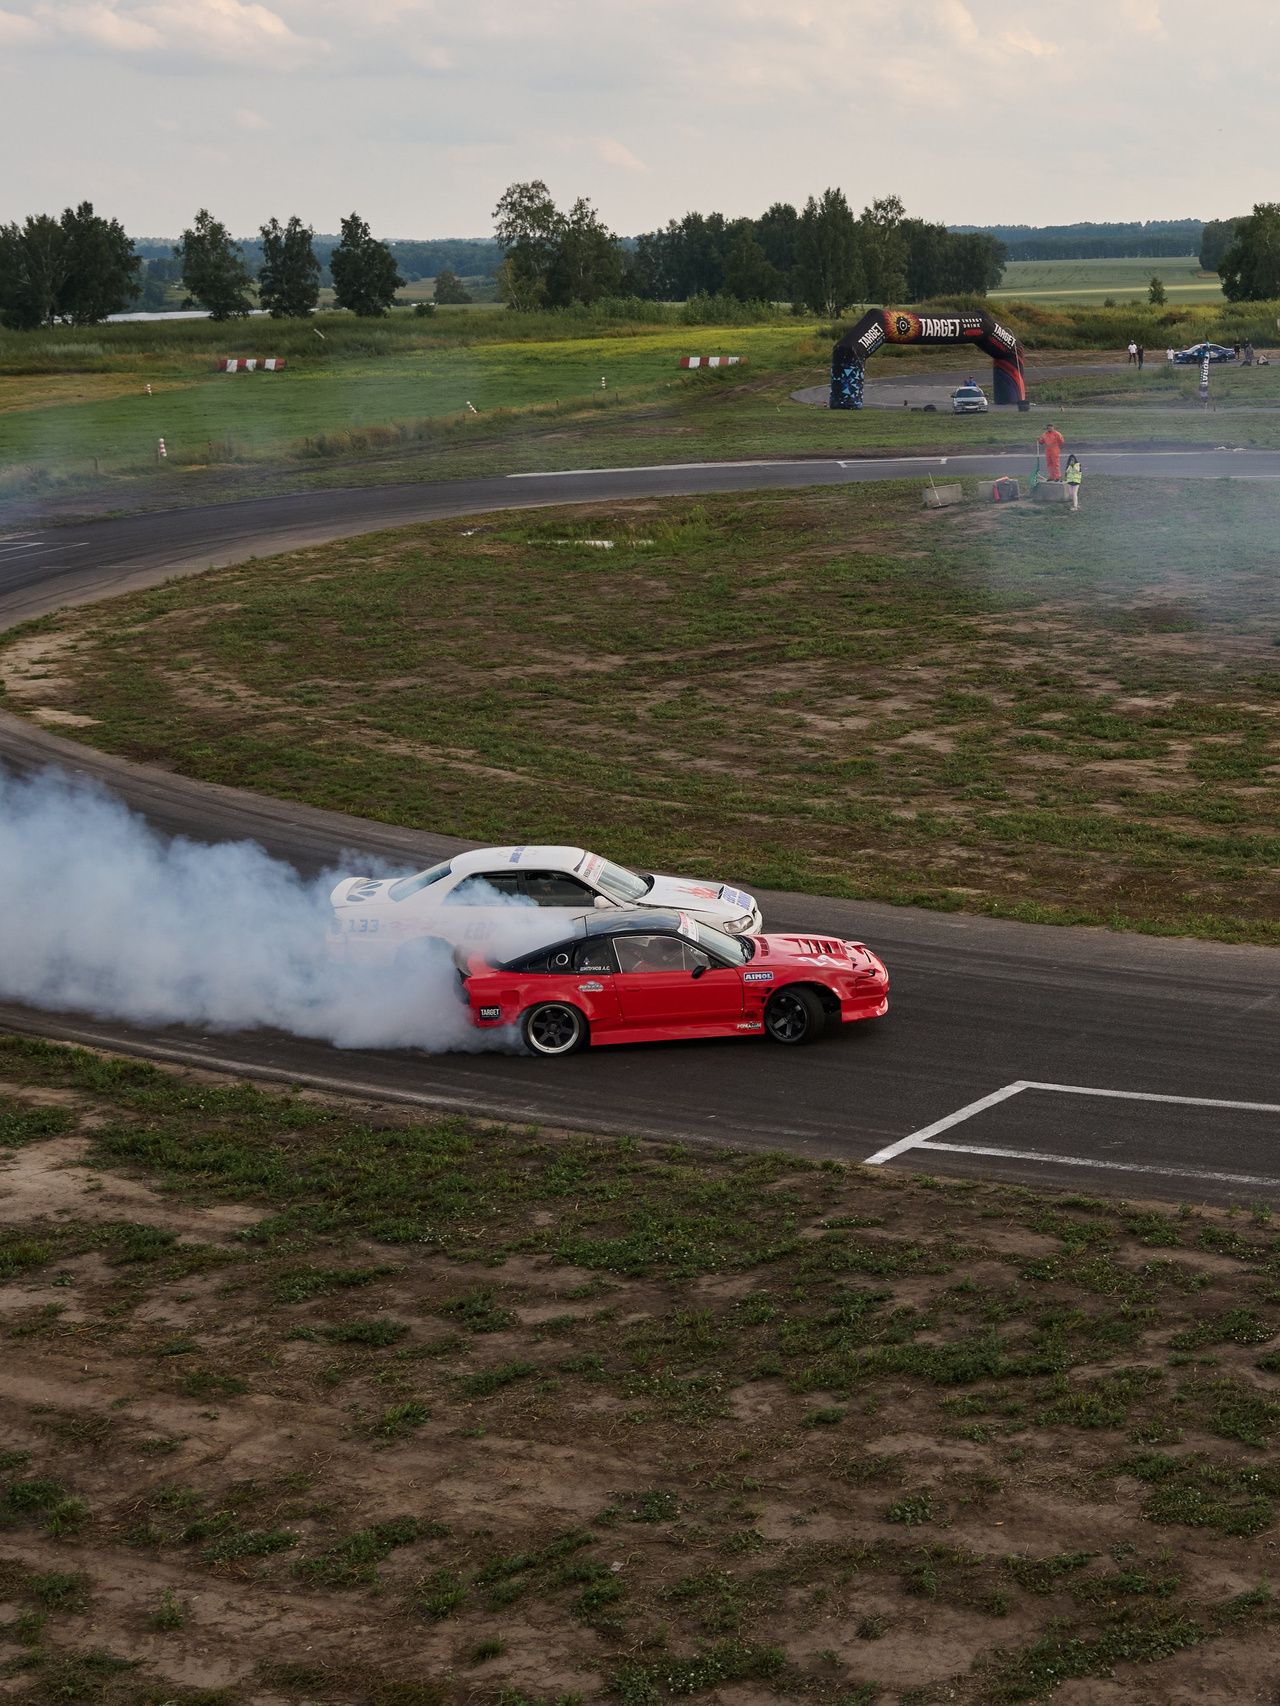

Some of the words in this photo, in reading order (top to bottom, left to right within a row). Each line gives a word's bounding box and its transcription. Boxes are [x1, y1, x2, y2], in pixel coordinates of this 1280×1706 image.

[858, 322, 883, 348] TARGET
[919, 318, 960, 337] TARGET
[993, 322, 1016, 347] TARGET
[348, 919, 379, 933] 133
[797, 955, 847, 966] 22
[480, 1008, 500, 1016] TARGET
